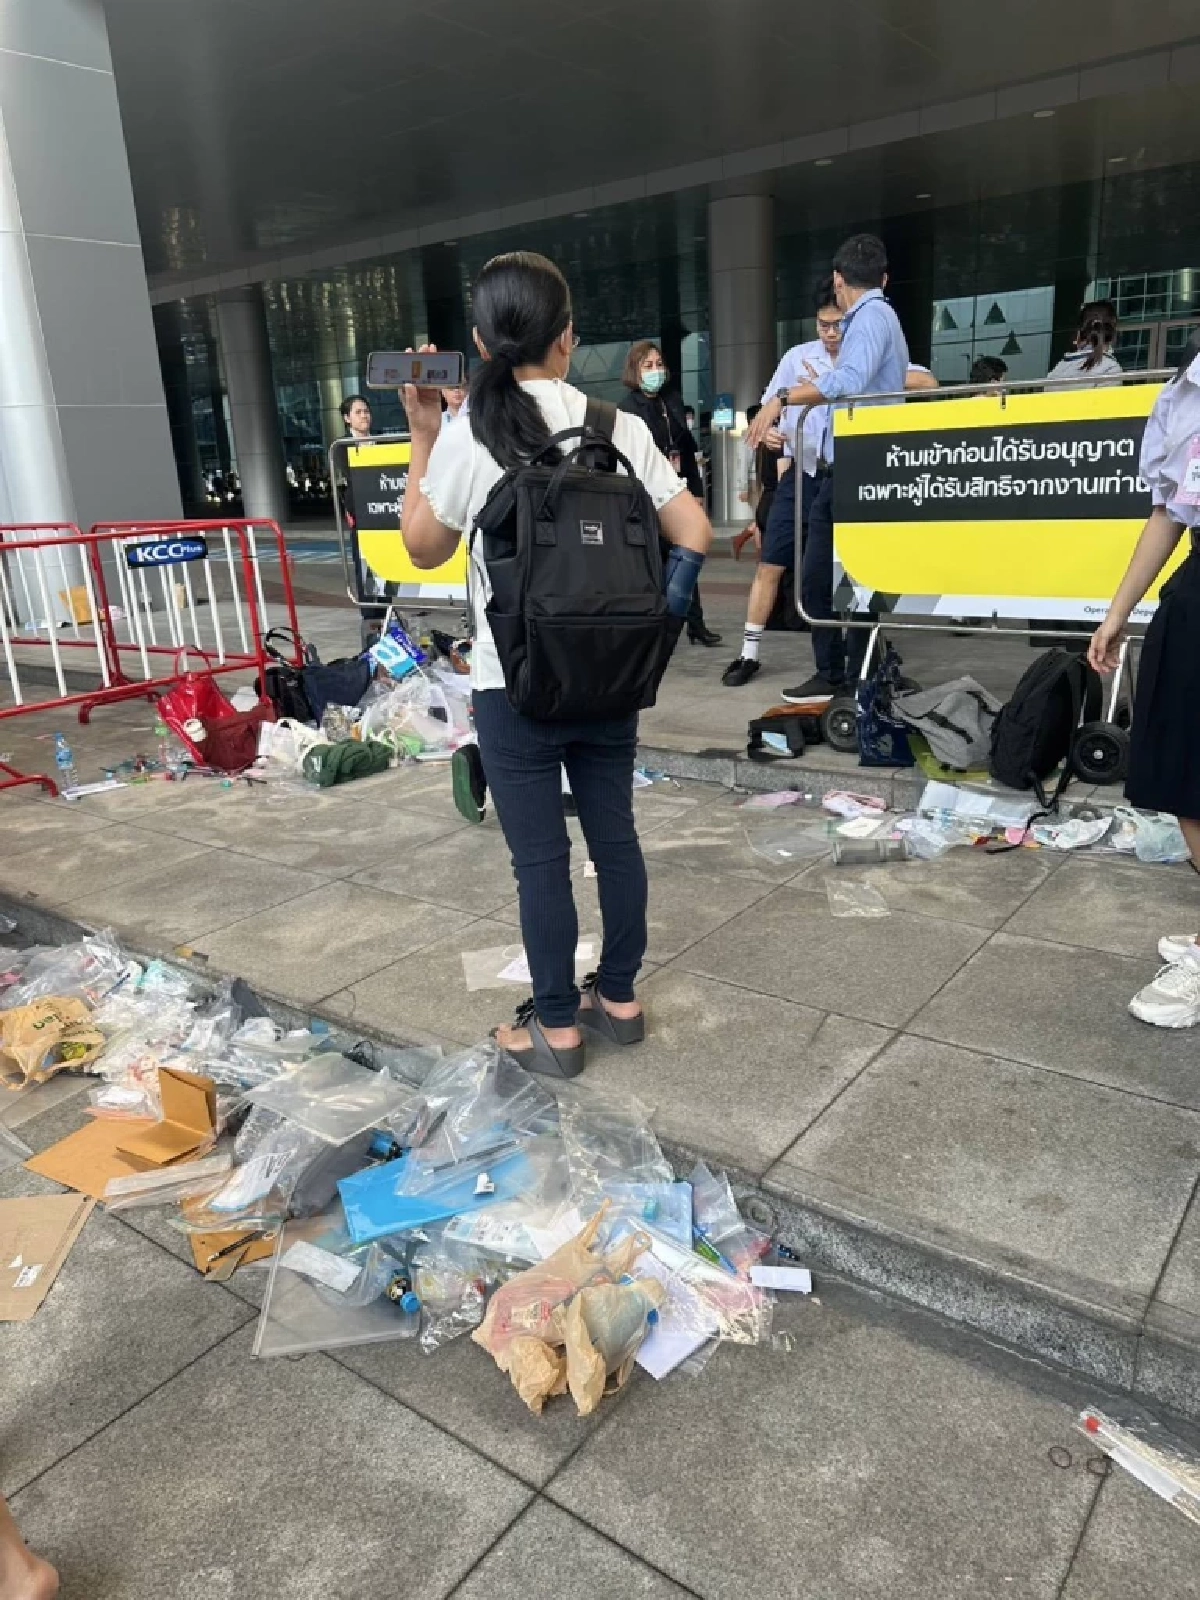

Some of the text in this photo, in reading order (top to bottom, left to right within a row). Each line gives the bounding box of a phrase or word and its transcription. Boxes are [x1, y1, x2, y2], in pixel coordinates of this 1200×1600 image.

[886, 436, 1134, 467] ห้ามเข้าก่อนได้รับอนุญาต
[858, 469, 1151, 506] เฉพาะผู้ได้รับสิทธิจากงานเท่าน
[136, 543, 184, 562] KCC
